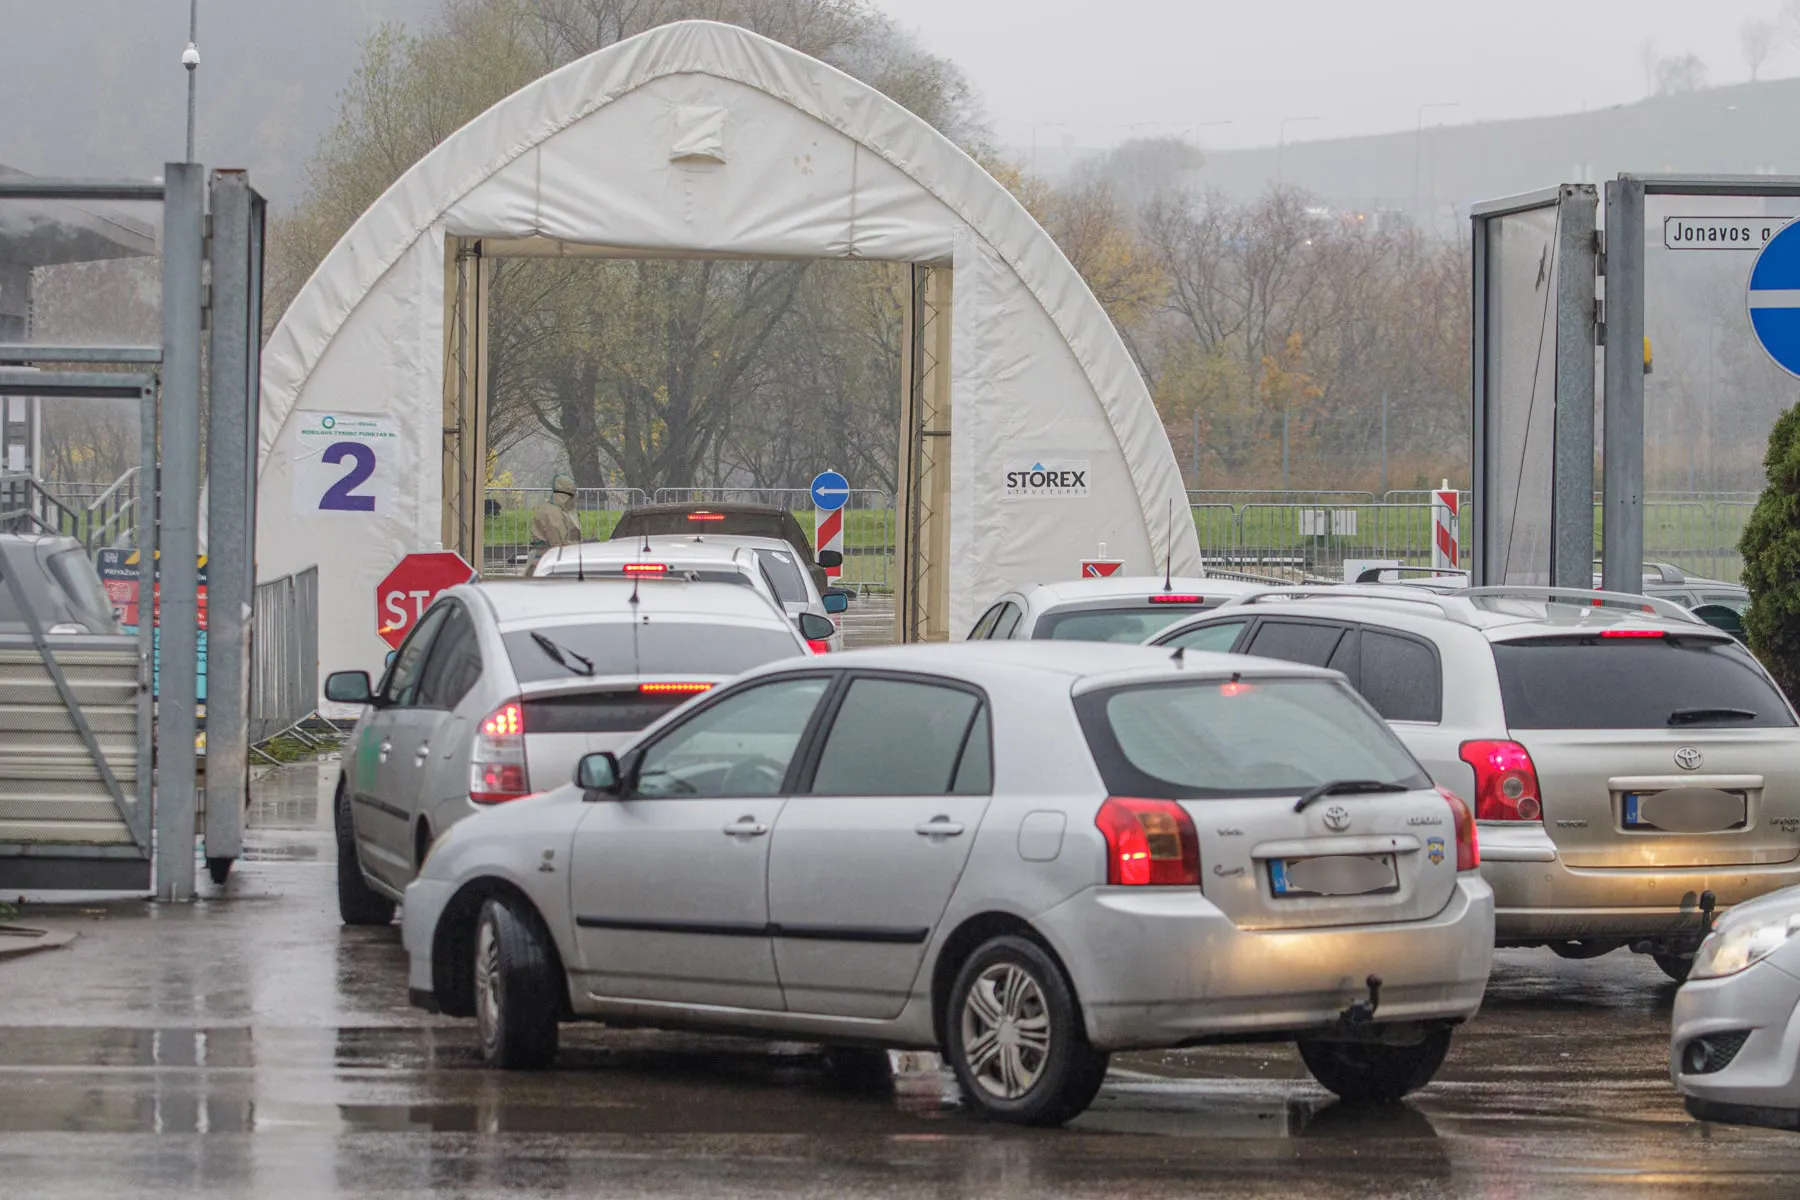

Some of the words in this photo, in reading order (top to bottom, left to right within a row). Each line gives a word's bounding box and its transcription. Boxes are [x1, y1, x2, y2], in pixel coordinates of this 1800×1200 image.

[1673, 221, 1751, 242] Jonavos
[318, 441, 376, 511] 2
[1006, 470, 1086, 488] STOREX
[385, 590, 430, 630] ST
